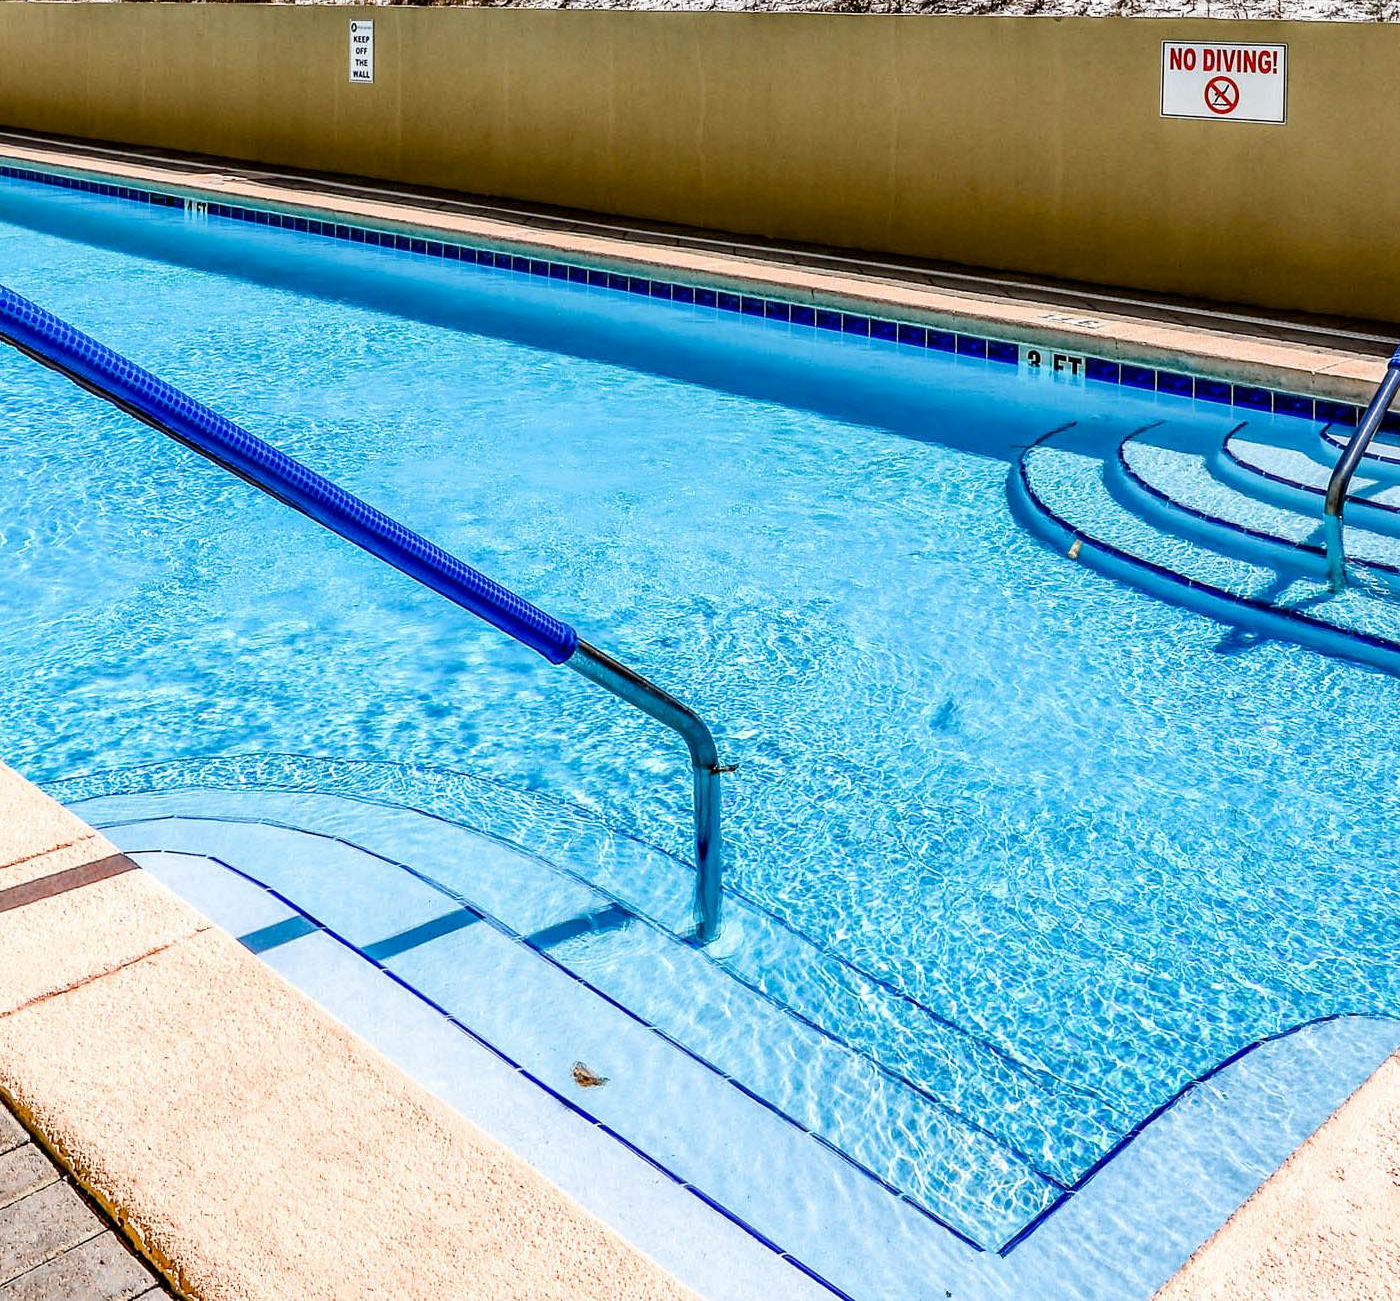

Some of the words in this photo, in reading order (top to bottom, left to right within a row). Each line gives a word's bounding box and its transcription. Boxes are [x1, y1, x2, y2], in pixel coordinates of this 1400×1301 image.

[353, 35, 370, 43] KEEP
[355, 47, 368, 55] OFF
[355, 59, 368, 67] THE
[1170, 47, 1197, 71] NO
[1203, 48, 1278, 74] DIVING!
[352, 71, 370, 79] WALL
[1053, 353, 1082, 376] FT
